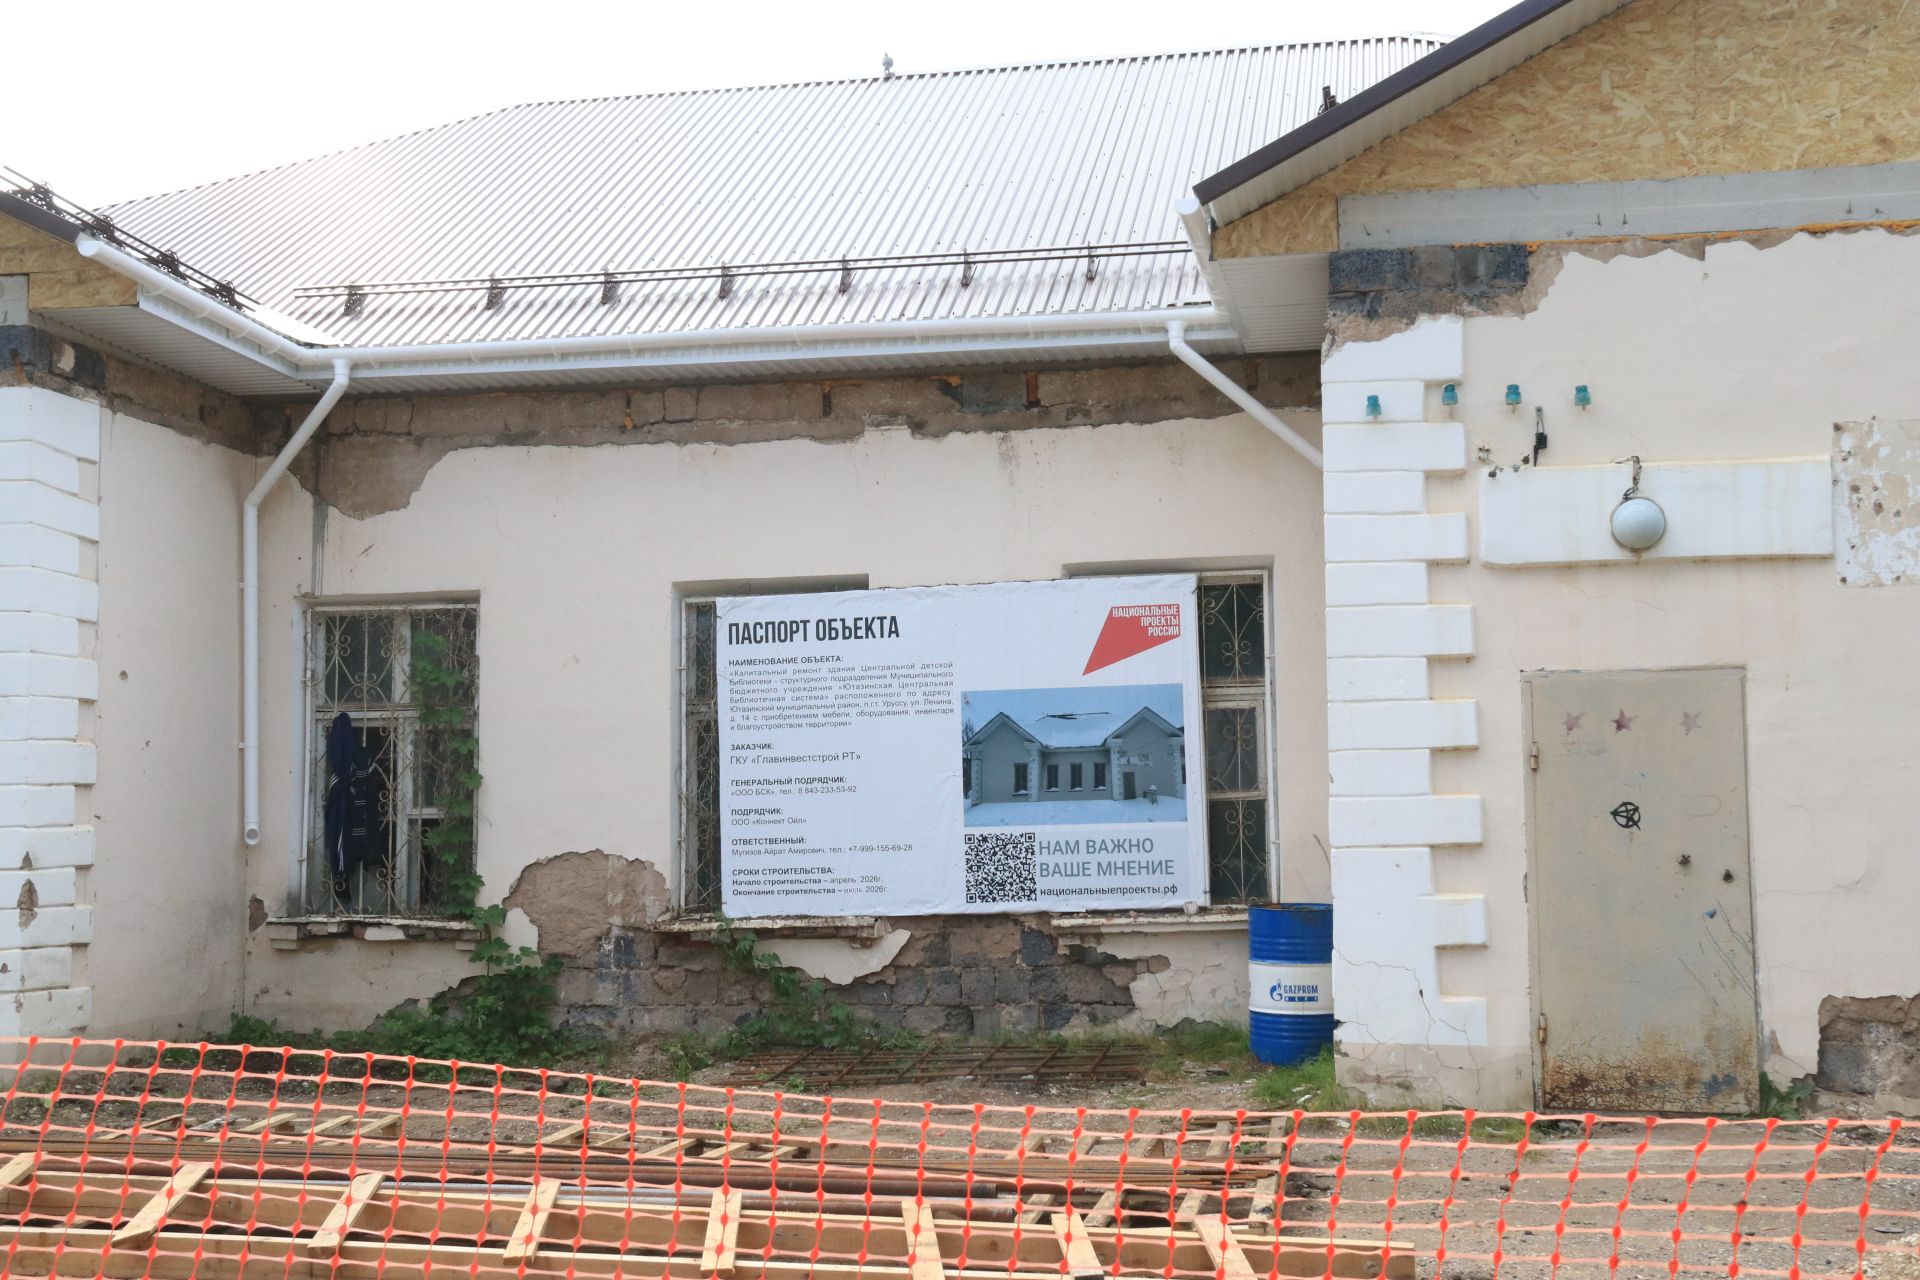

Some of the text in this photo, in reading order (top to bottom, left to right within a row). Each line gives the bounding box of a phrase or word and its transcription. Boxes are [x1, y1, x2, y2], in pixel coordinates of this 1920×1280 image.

[1112, 605, 1178, 618] НАЦИОНАЛЬНЫЕ
[1141, 616, 1178, 627] ПРОЕКТЫ
[728, 615, 900, 645] ПАСПОРТ ОБЪЕКТА
[1148, 626, 1179, 637] РОССИИ
[728, 655, 844, 667] НАИМЕНОВАНИЕ ОБЪЕКТА:
[861, 663, 915, 672] Центральной
[920, 662, 953, 670] детской
[729, 678, 772, 686] библиотеки
[780, 676, 828, 685] структурного
[831, 675, 888, 683] подразделения
[890, 672, 954, 680] Муниципального
[783, 685, 833, 693] учреждения
[838, 683, 893, 691] «Ютазинская
[898, 681, 954, 689] Центральная
[834, 691, 902, 700] расположенного
[922, 689, 954, 698] адресу:
[730, 704, 775, 712] Ютазинский
[776, 702, 836, 712] муниципальный
[910, 699, 922, 707] ул.
[923, 698, 954, 706] Ленина,
[761, 712, 819, 722] приобретением
[822, 710, 852, 718] мебели,
[855, 709, 911, 718] оборудования,
[914, 707, 955, 715] инвентаря
[736, 722, 803, 731] благоустройством
[804, 721, 852, 729] территории»
[730, 751, 861, 766] ГКУ «Главинвестстрой РТ»
[731, 776, 848, 786] ГЕНЕРАЛЬНЫЙ ПОДРЯДЧИК:
[731, 808, 784, 817] ПОДРЯДЧИК:
[787, 817, 807, 825] Ойл»
[731, 837, 807, 846] ОТВЕТСТВЕННЫЙ:
[1039, 837, 1154, 856] НАМ ВАЖНО
[763, 847, 786, 856] Айрат
[787, 847, 827, 855] Амирович,
[848, 844, 913, 852] +7-999-155-69-28
[761, 867, 835, 876] СТРОИТЕЛЬСТВА:
[1039, 858, 1175, 878] ВАШЕ МНЕНИЕ
[829, 877, 857, 885] апрель
[860, 875, 884, 883] 2026г.
[777, 887, 836, 895] строительства
[865, 885, 889, 893] 2026г.
[1040, 884, 1178, 898] национальныепроекты.рф
[1284, 985, 1318, 994] GAZPROM
